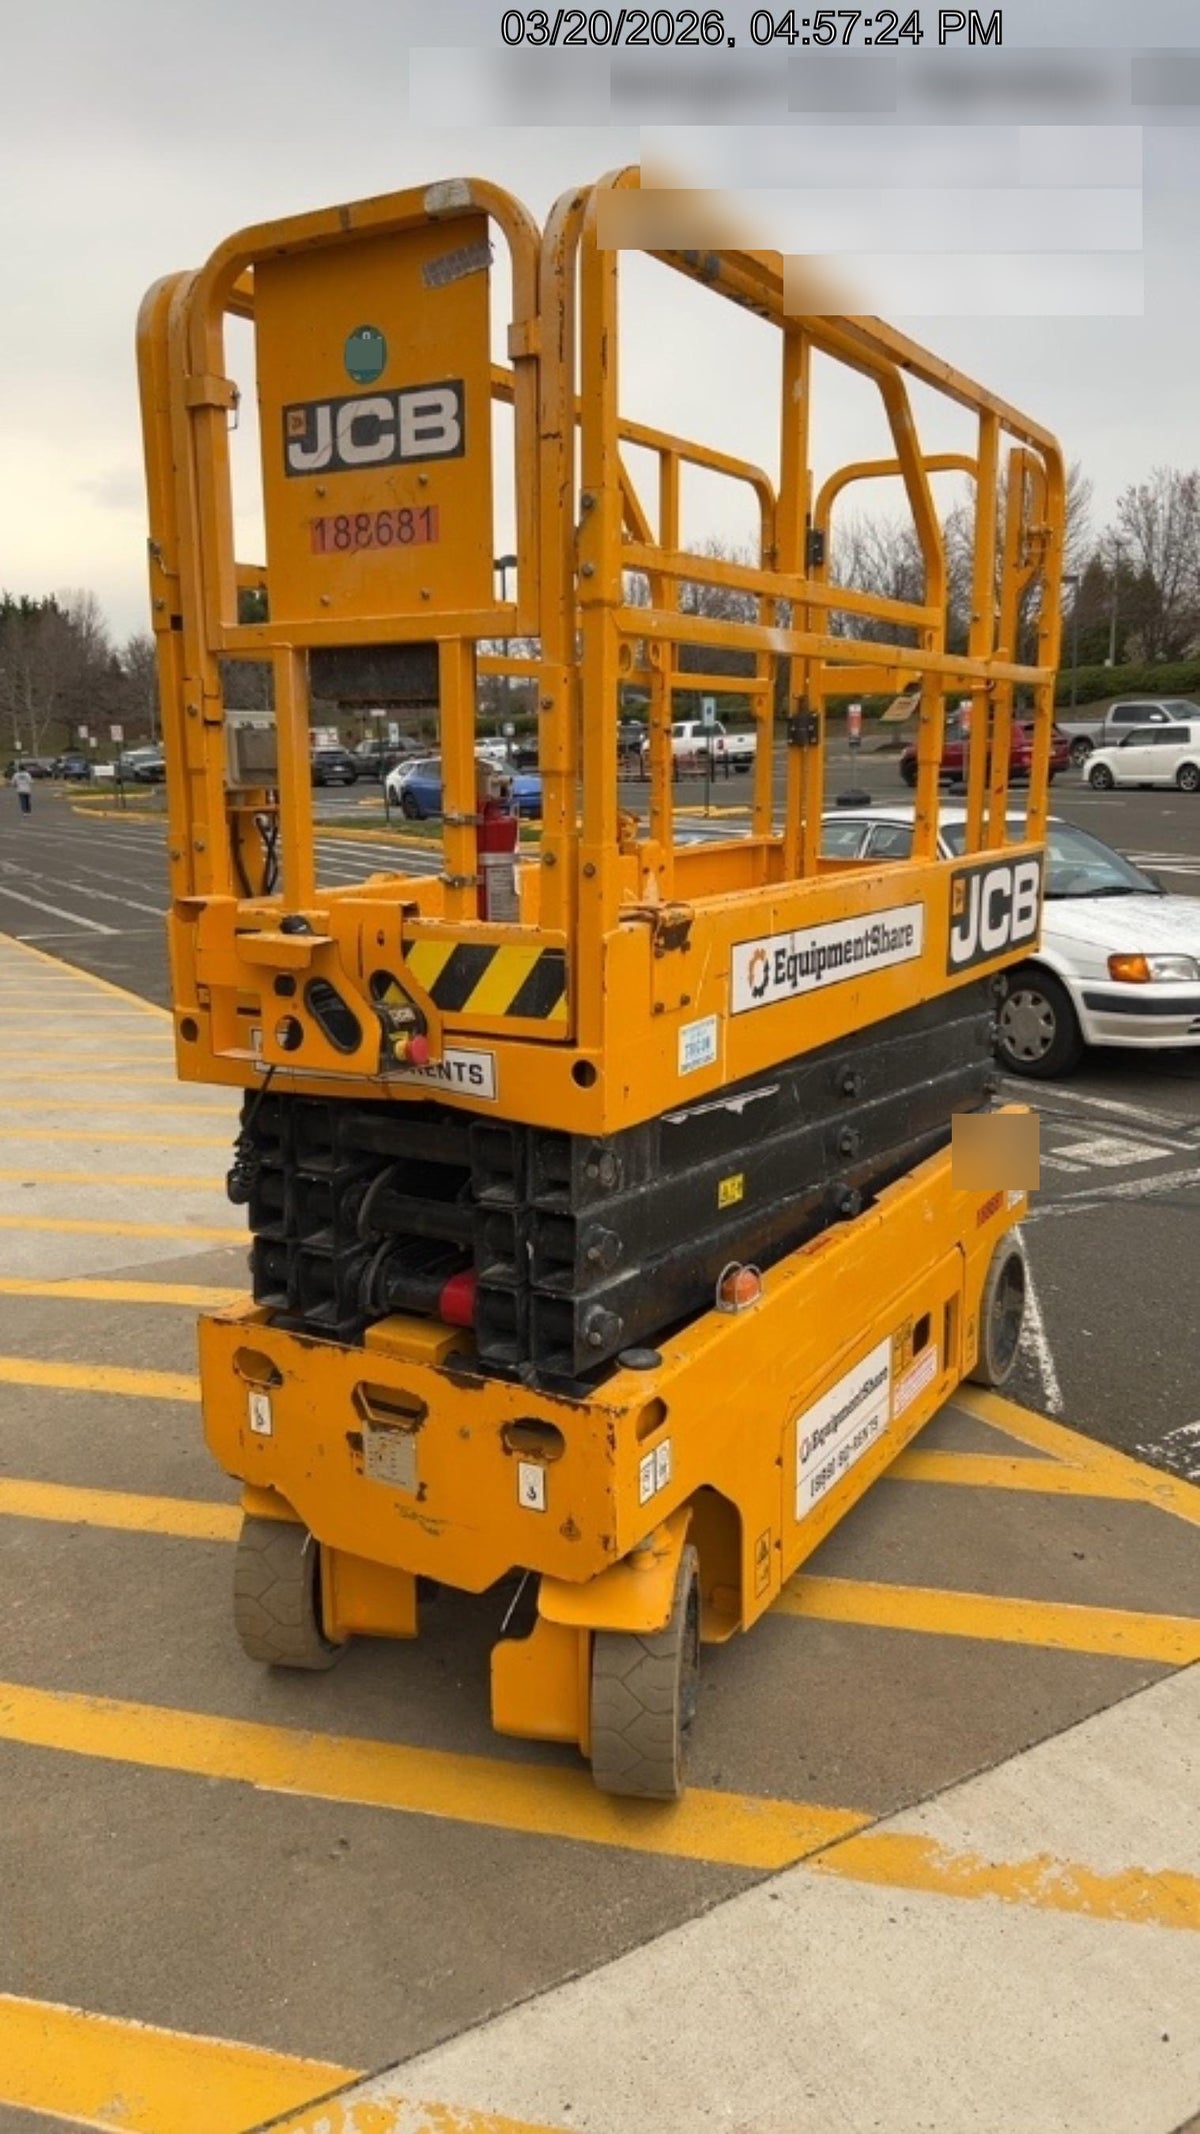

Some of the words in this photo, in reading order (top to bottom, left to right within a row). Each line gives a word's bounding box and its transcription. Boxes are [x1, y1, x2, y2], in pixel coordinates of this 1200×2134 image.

[287, 388, 461, 470] JCB
[314, 506, 433, 551] 188681
[950, 861, 1040, 963] JCB
[773, 923, 914, 988] EquipmentShare
